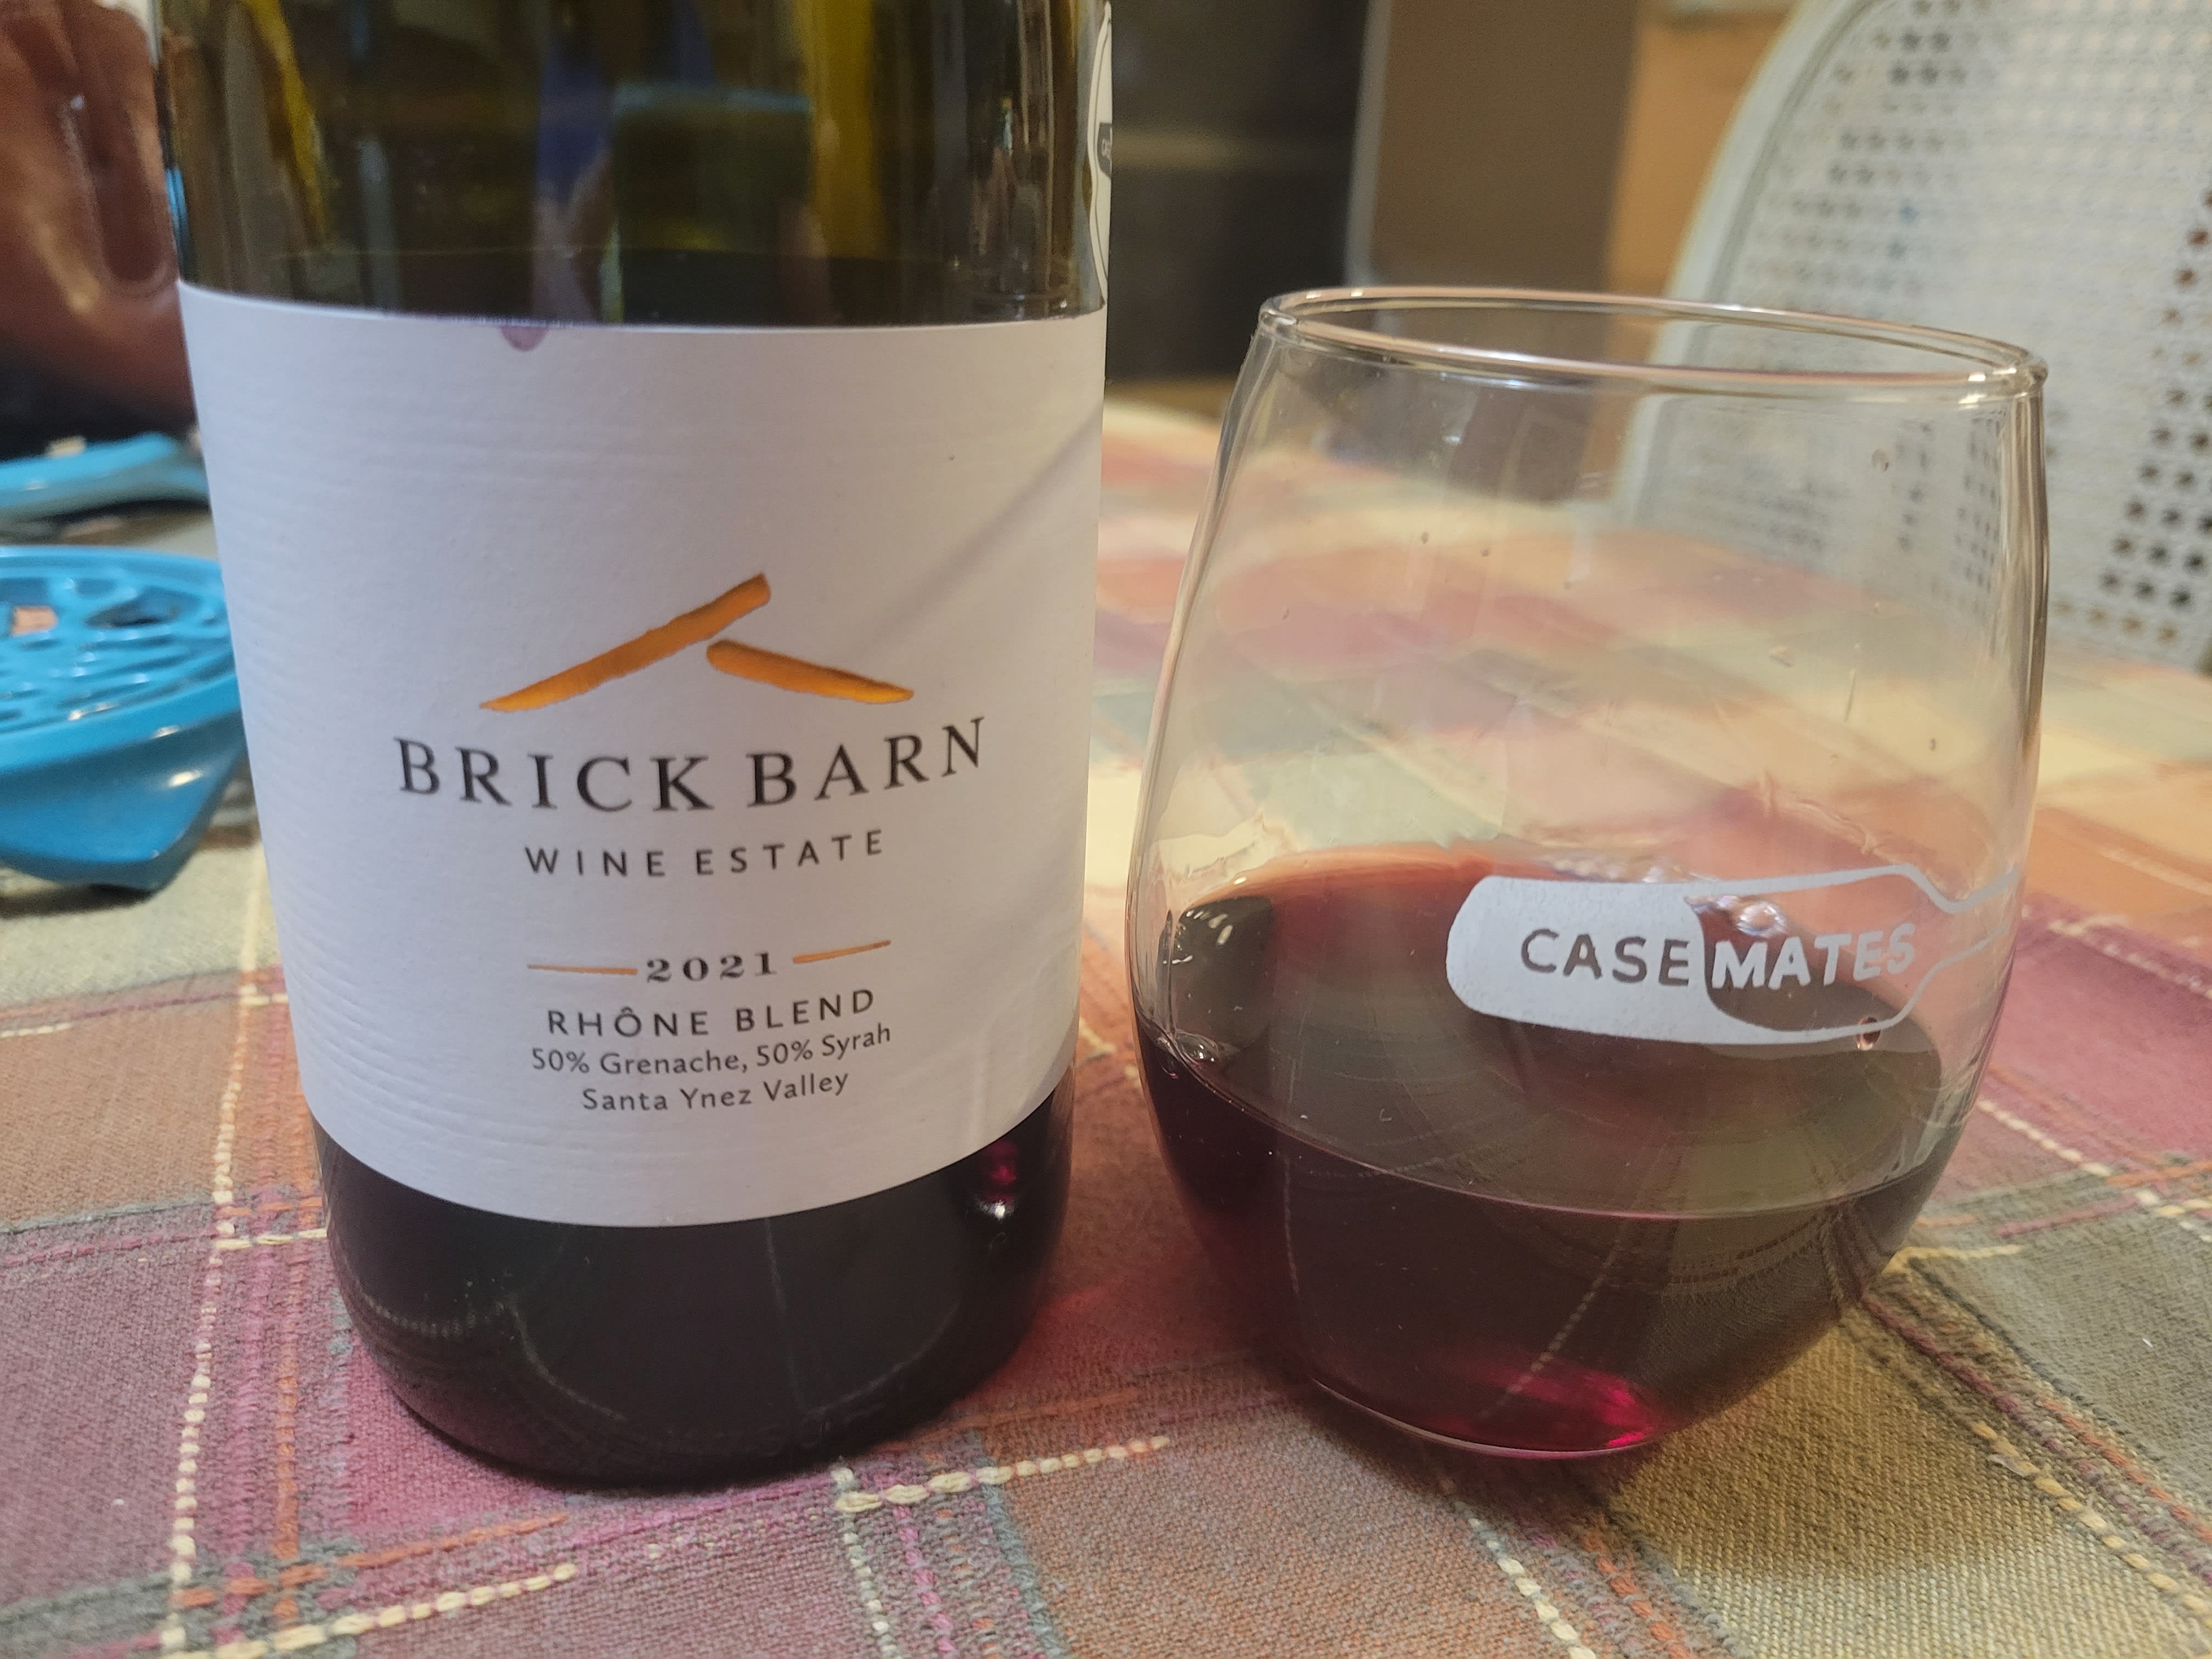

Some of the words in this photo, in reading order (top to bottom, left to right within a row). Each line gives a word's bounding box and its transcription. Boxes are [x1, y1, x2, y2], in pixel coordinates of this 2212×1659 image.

[393, 736, 714, 812] BRICK
[746, 717, 985, 808] BARN
[526, 846, 665, 877] WINE
[696, 830, 884, 876] ESTATE
[646, 952, 777, 983] 2021
[549, 1007, 709, 1038] RHÔNE
[736, 989, 874, 1032] BLEND
[532, 1048, 590, 1074] 50%
[600, 1049, 749, 1076] Grenache,
[757, 1042, 814, 1069] 50%
[821, 1023, 891, 1059] Syrah
[583, 1087, 668, 1111] Santa
[680, 1086, 753, 1113] Ynez
[763, 1071, 848, 1103] Valley
